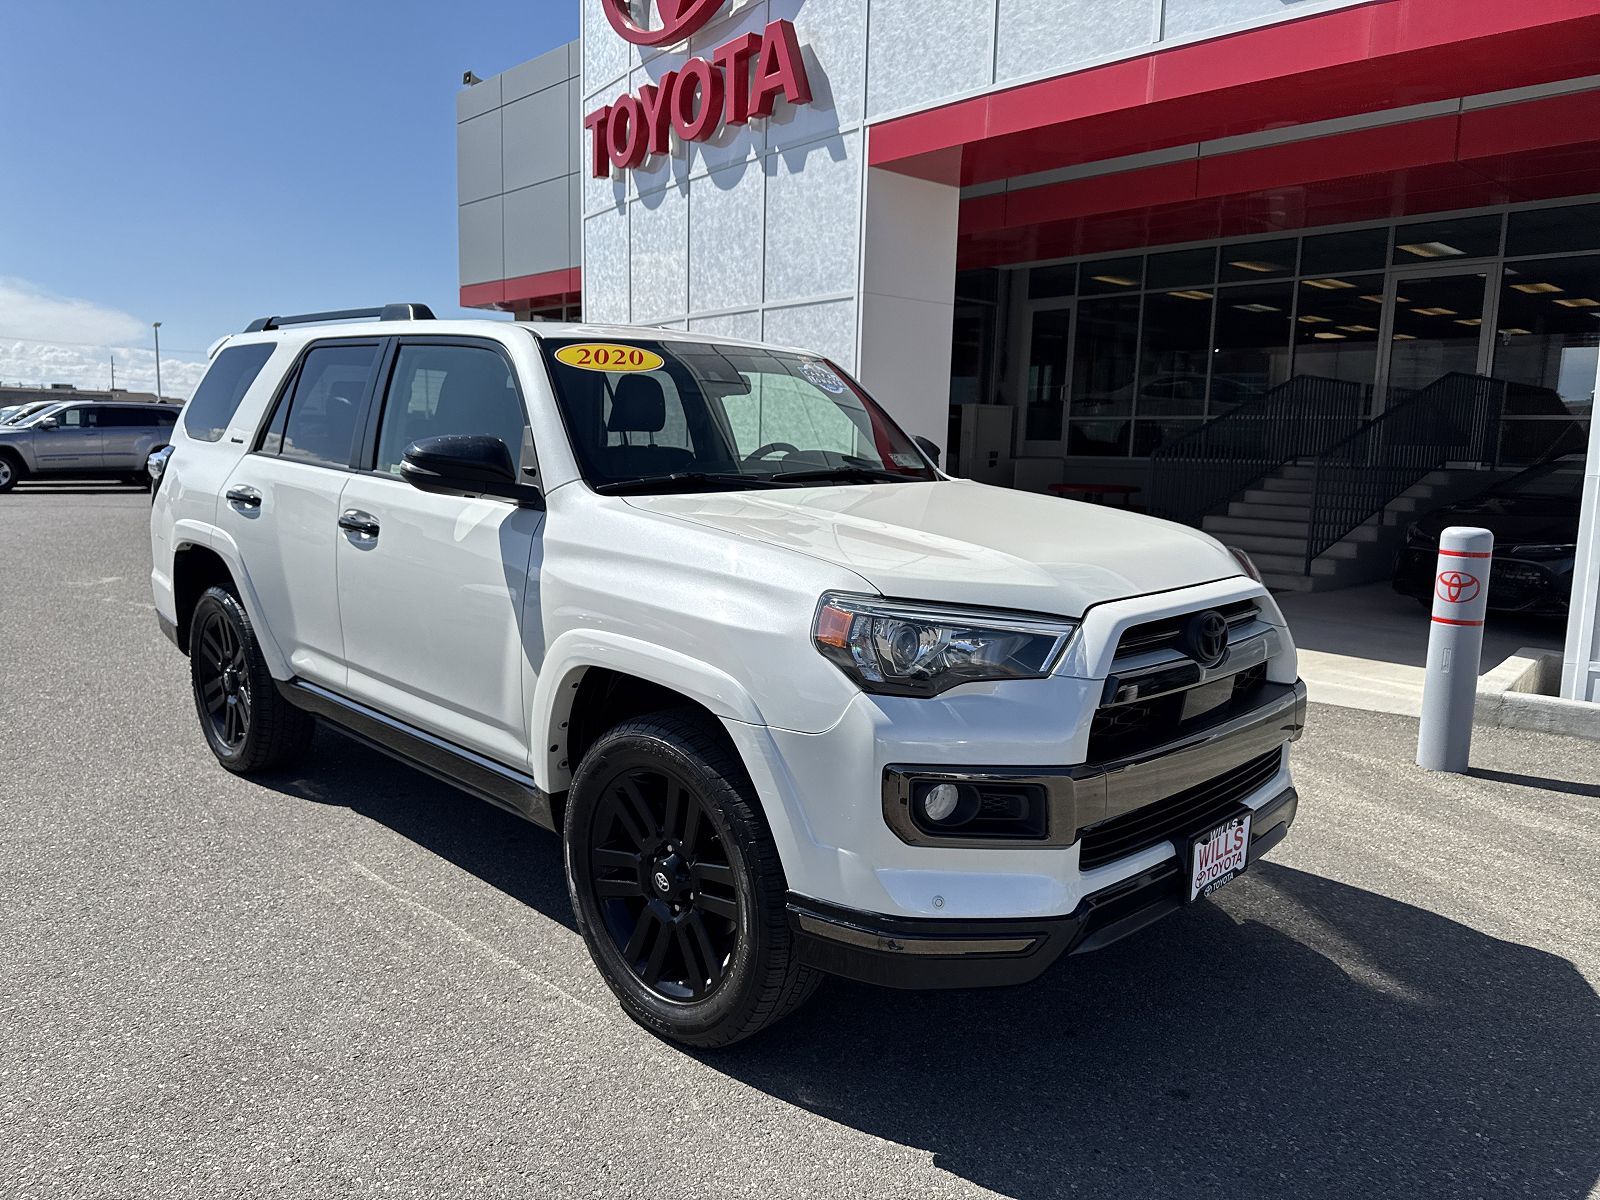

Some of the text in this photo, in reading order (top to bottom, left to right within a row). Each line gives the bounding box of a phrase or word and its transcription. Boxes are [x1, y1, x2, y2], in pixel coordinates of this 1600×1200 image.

[585, 18, 813, 180] TOYOTA
[577, 349, 644, 366] 2020
[1199, 827, 1244, 870] WILLS
[1207, 852, 1242, 880] TOYOTA
[1213, 872, 1234, 890] TOYOTA
